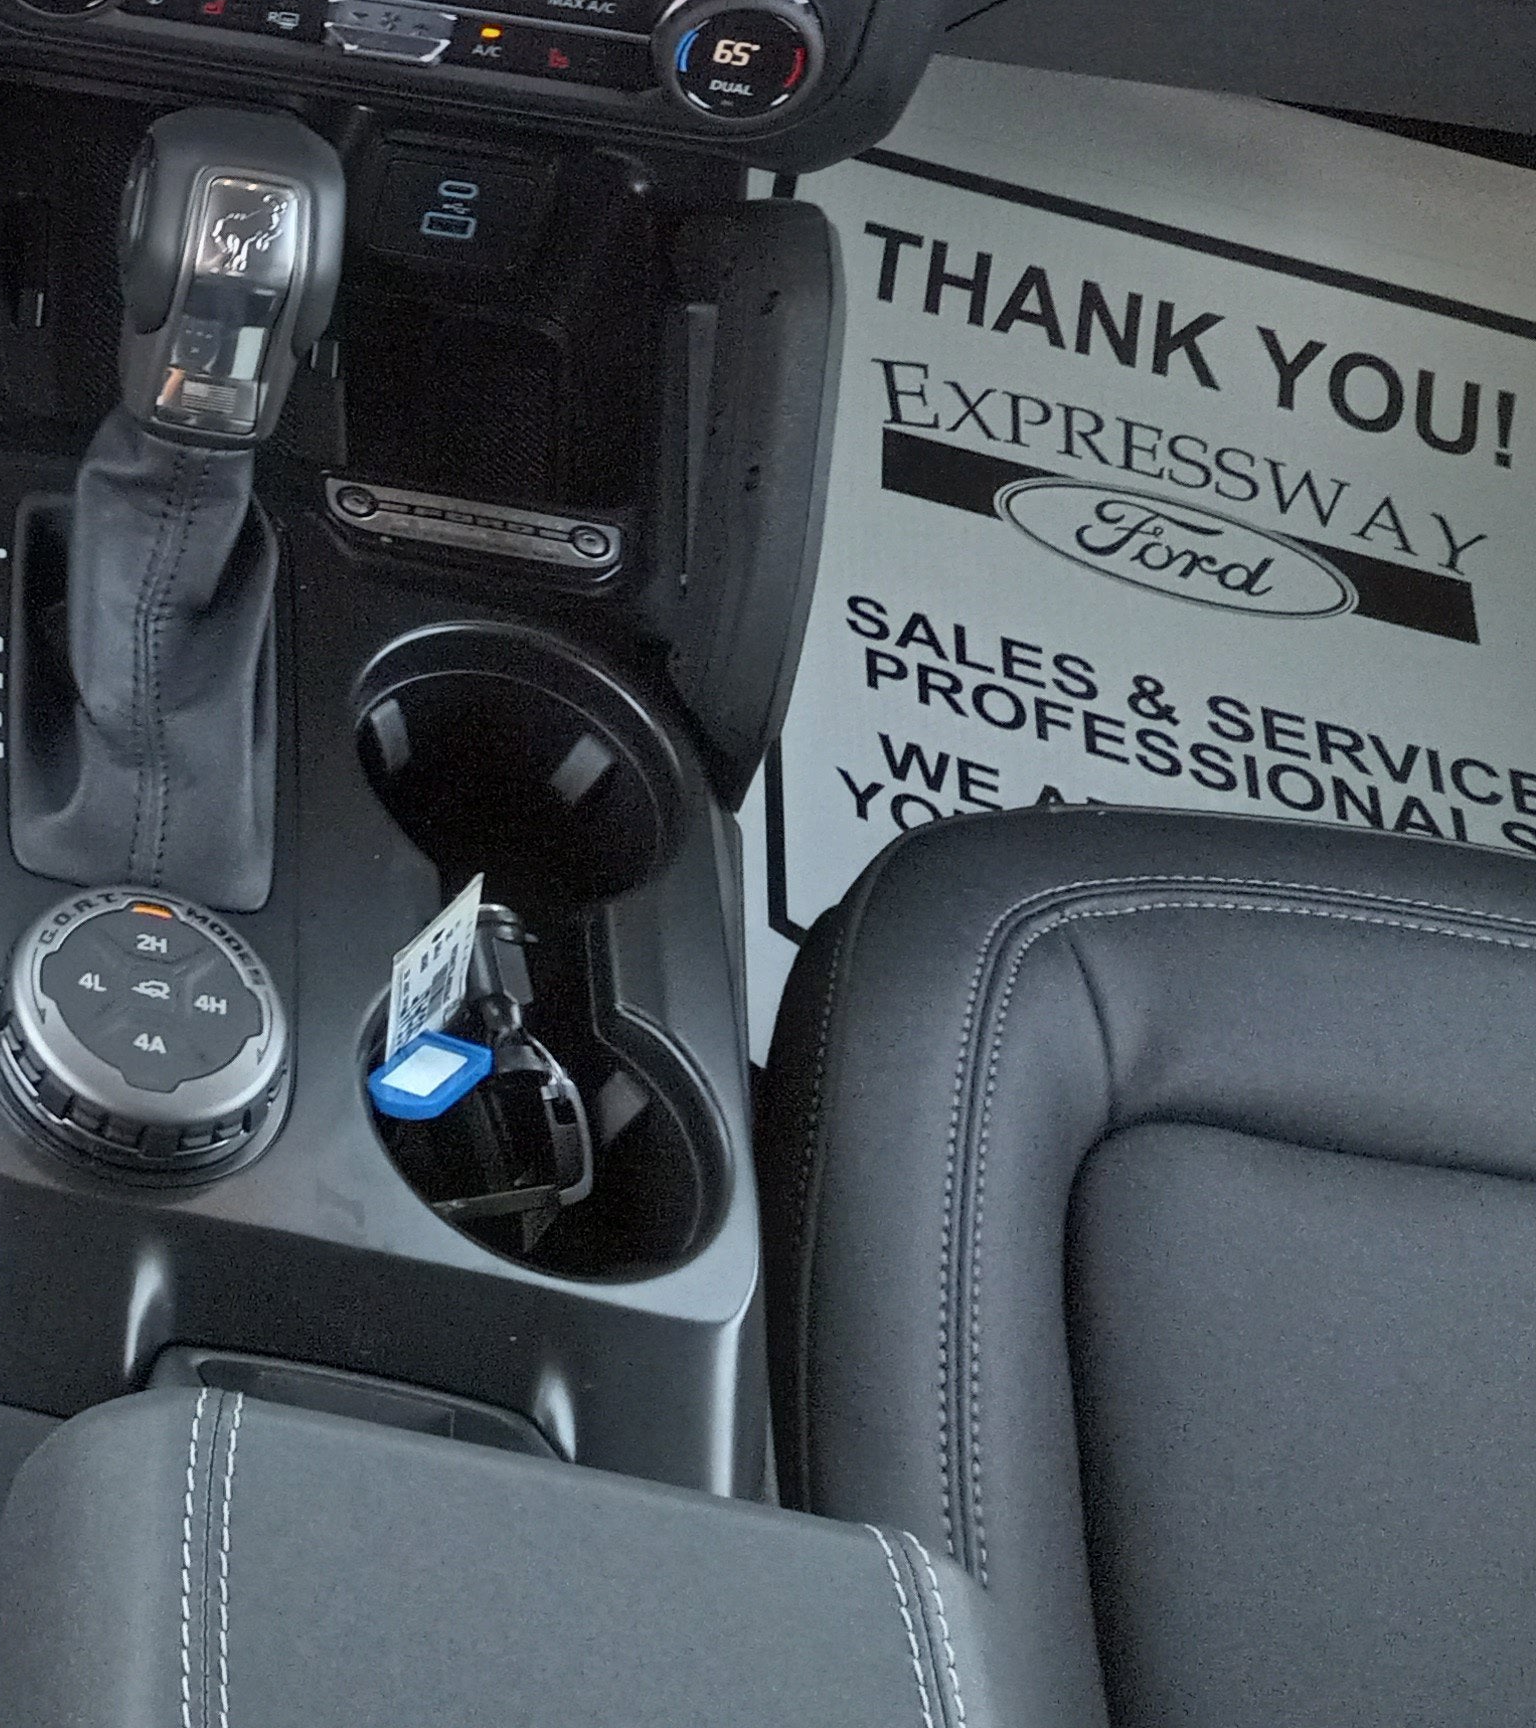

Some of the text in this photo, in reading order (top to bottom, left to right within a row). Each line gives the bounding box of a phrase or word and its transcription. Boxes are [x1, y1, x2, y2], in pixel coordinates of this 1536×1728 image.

[472, 44, 501, 59] A/C
[708, 79, 755, 98] DUAL
[863, 220, 1518, 470] THANK YOU!
[870, 356, 1488, 576] EXPRESSWAY
[1074, 497, 1274, 600] Ford
[845, 595, 1099, 700] SALES
[1128, 673, 1180, 726] &
[877, 731, 1003, 812] WE
[836, 766, 964, 832] YO
[136, 934, 168, 953] 2H
[78, 972, 107, 992] 4L
[193, 993, 228, 1016] 4H
[133, 1032, 167, 1056] 4A
